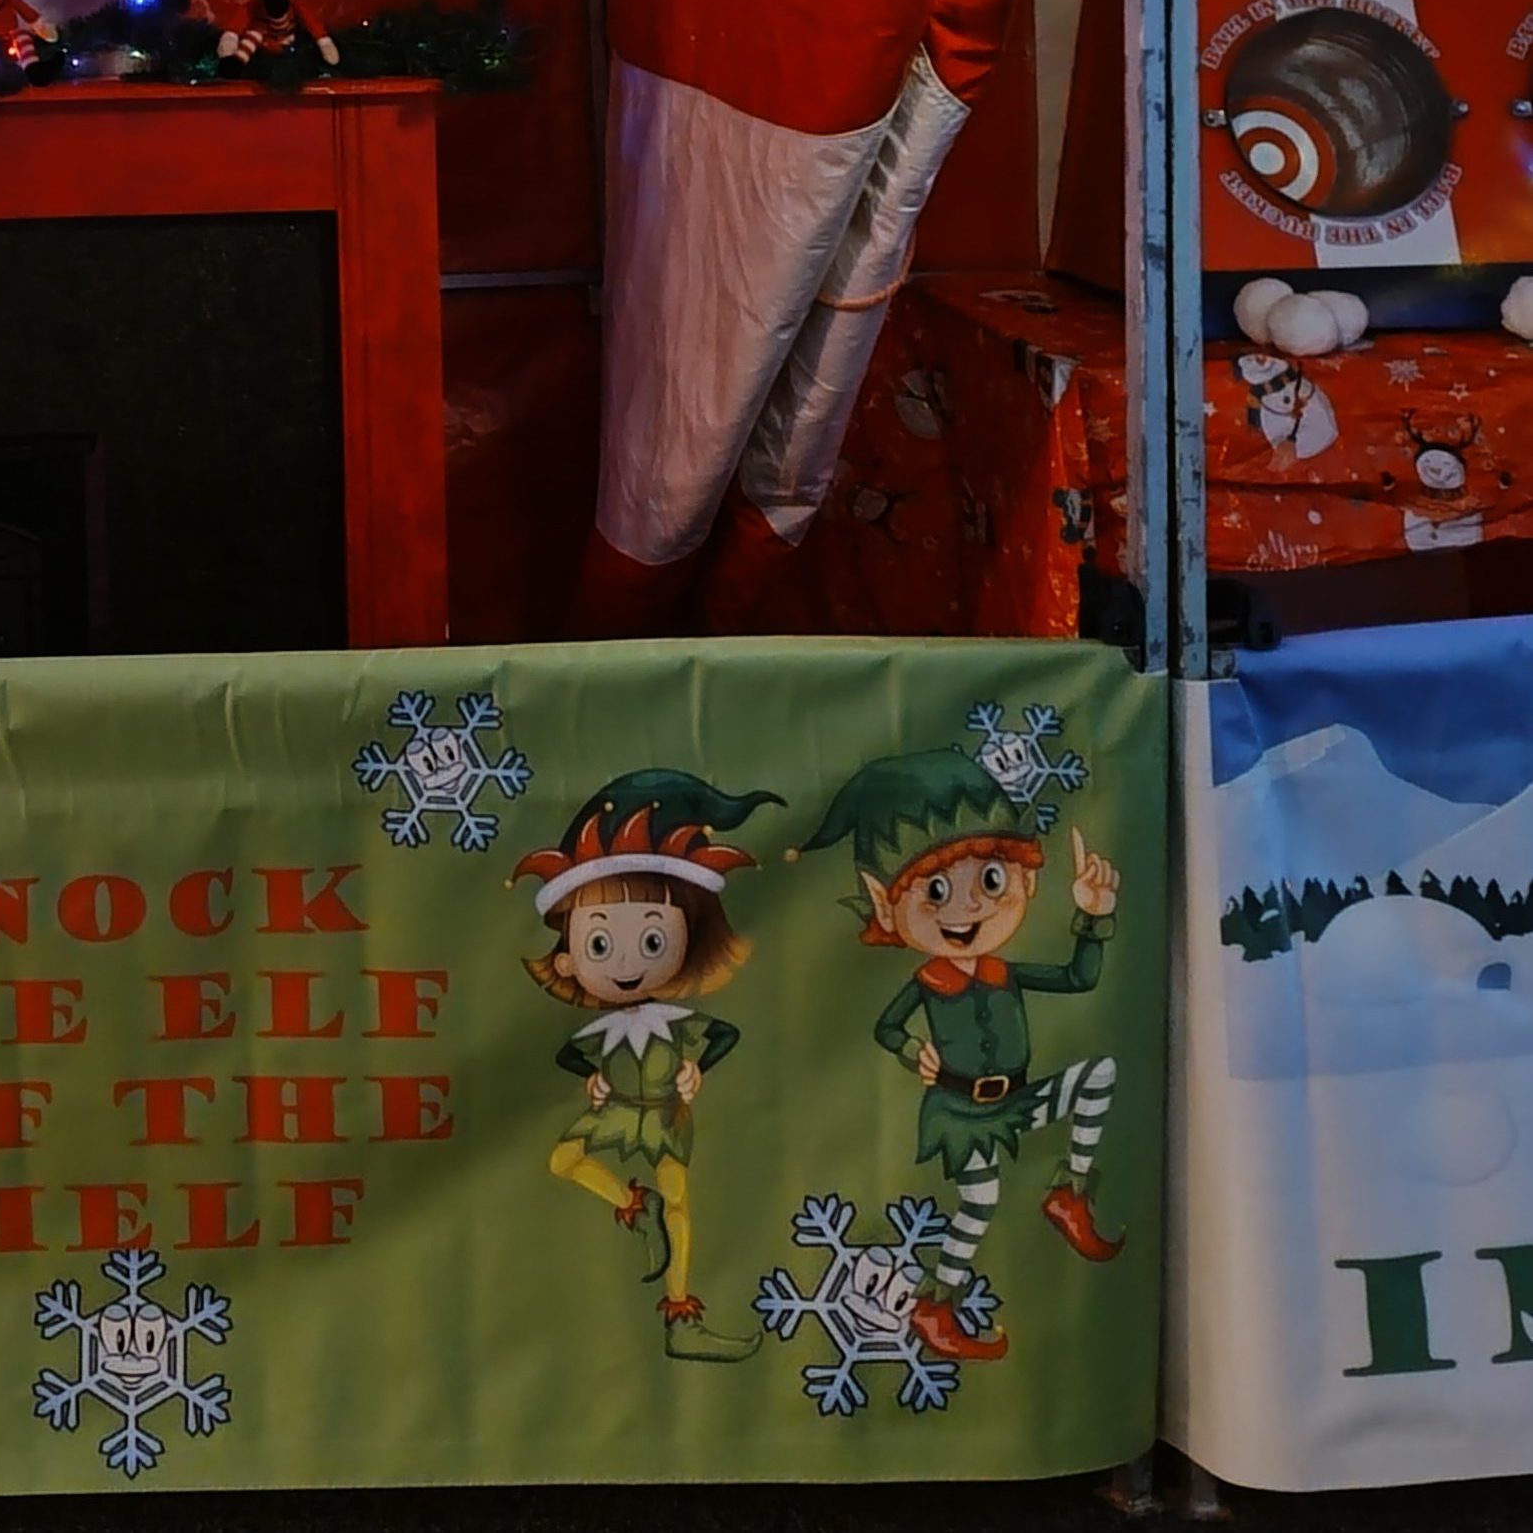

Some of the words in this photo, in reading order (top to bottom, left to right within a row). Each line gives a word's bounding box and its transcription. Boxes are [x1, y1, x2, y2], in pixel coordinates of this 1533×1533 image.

[1201, 14, 1252, 70] BALL
[1219, 170, 1321, 241] BUCKET
[1412, 163, 1462, 220] BALL
[1324, 223, 1384, 246] THE
[1380, 209, 1418, 240] IN
[148, 967, 450, 1042] ELF
[113, 1073, 455, 1148] THE
